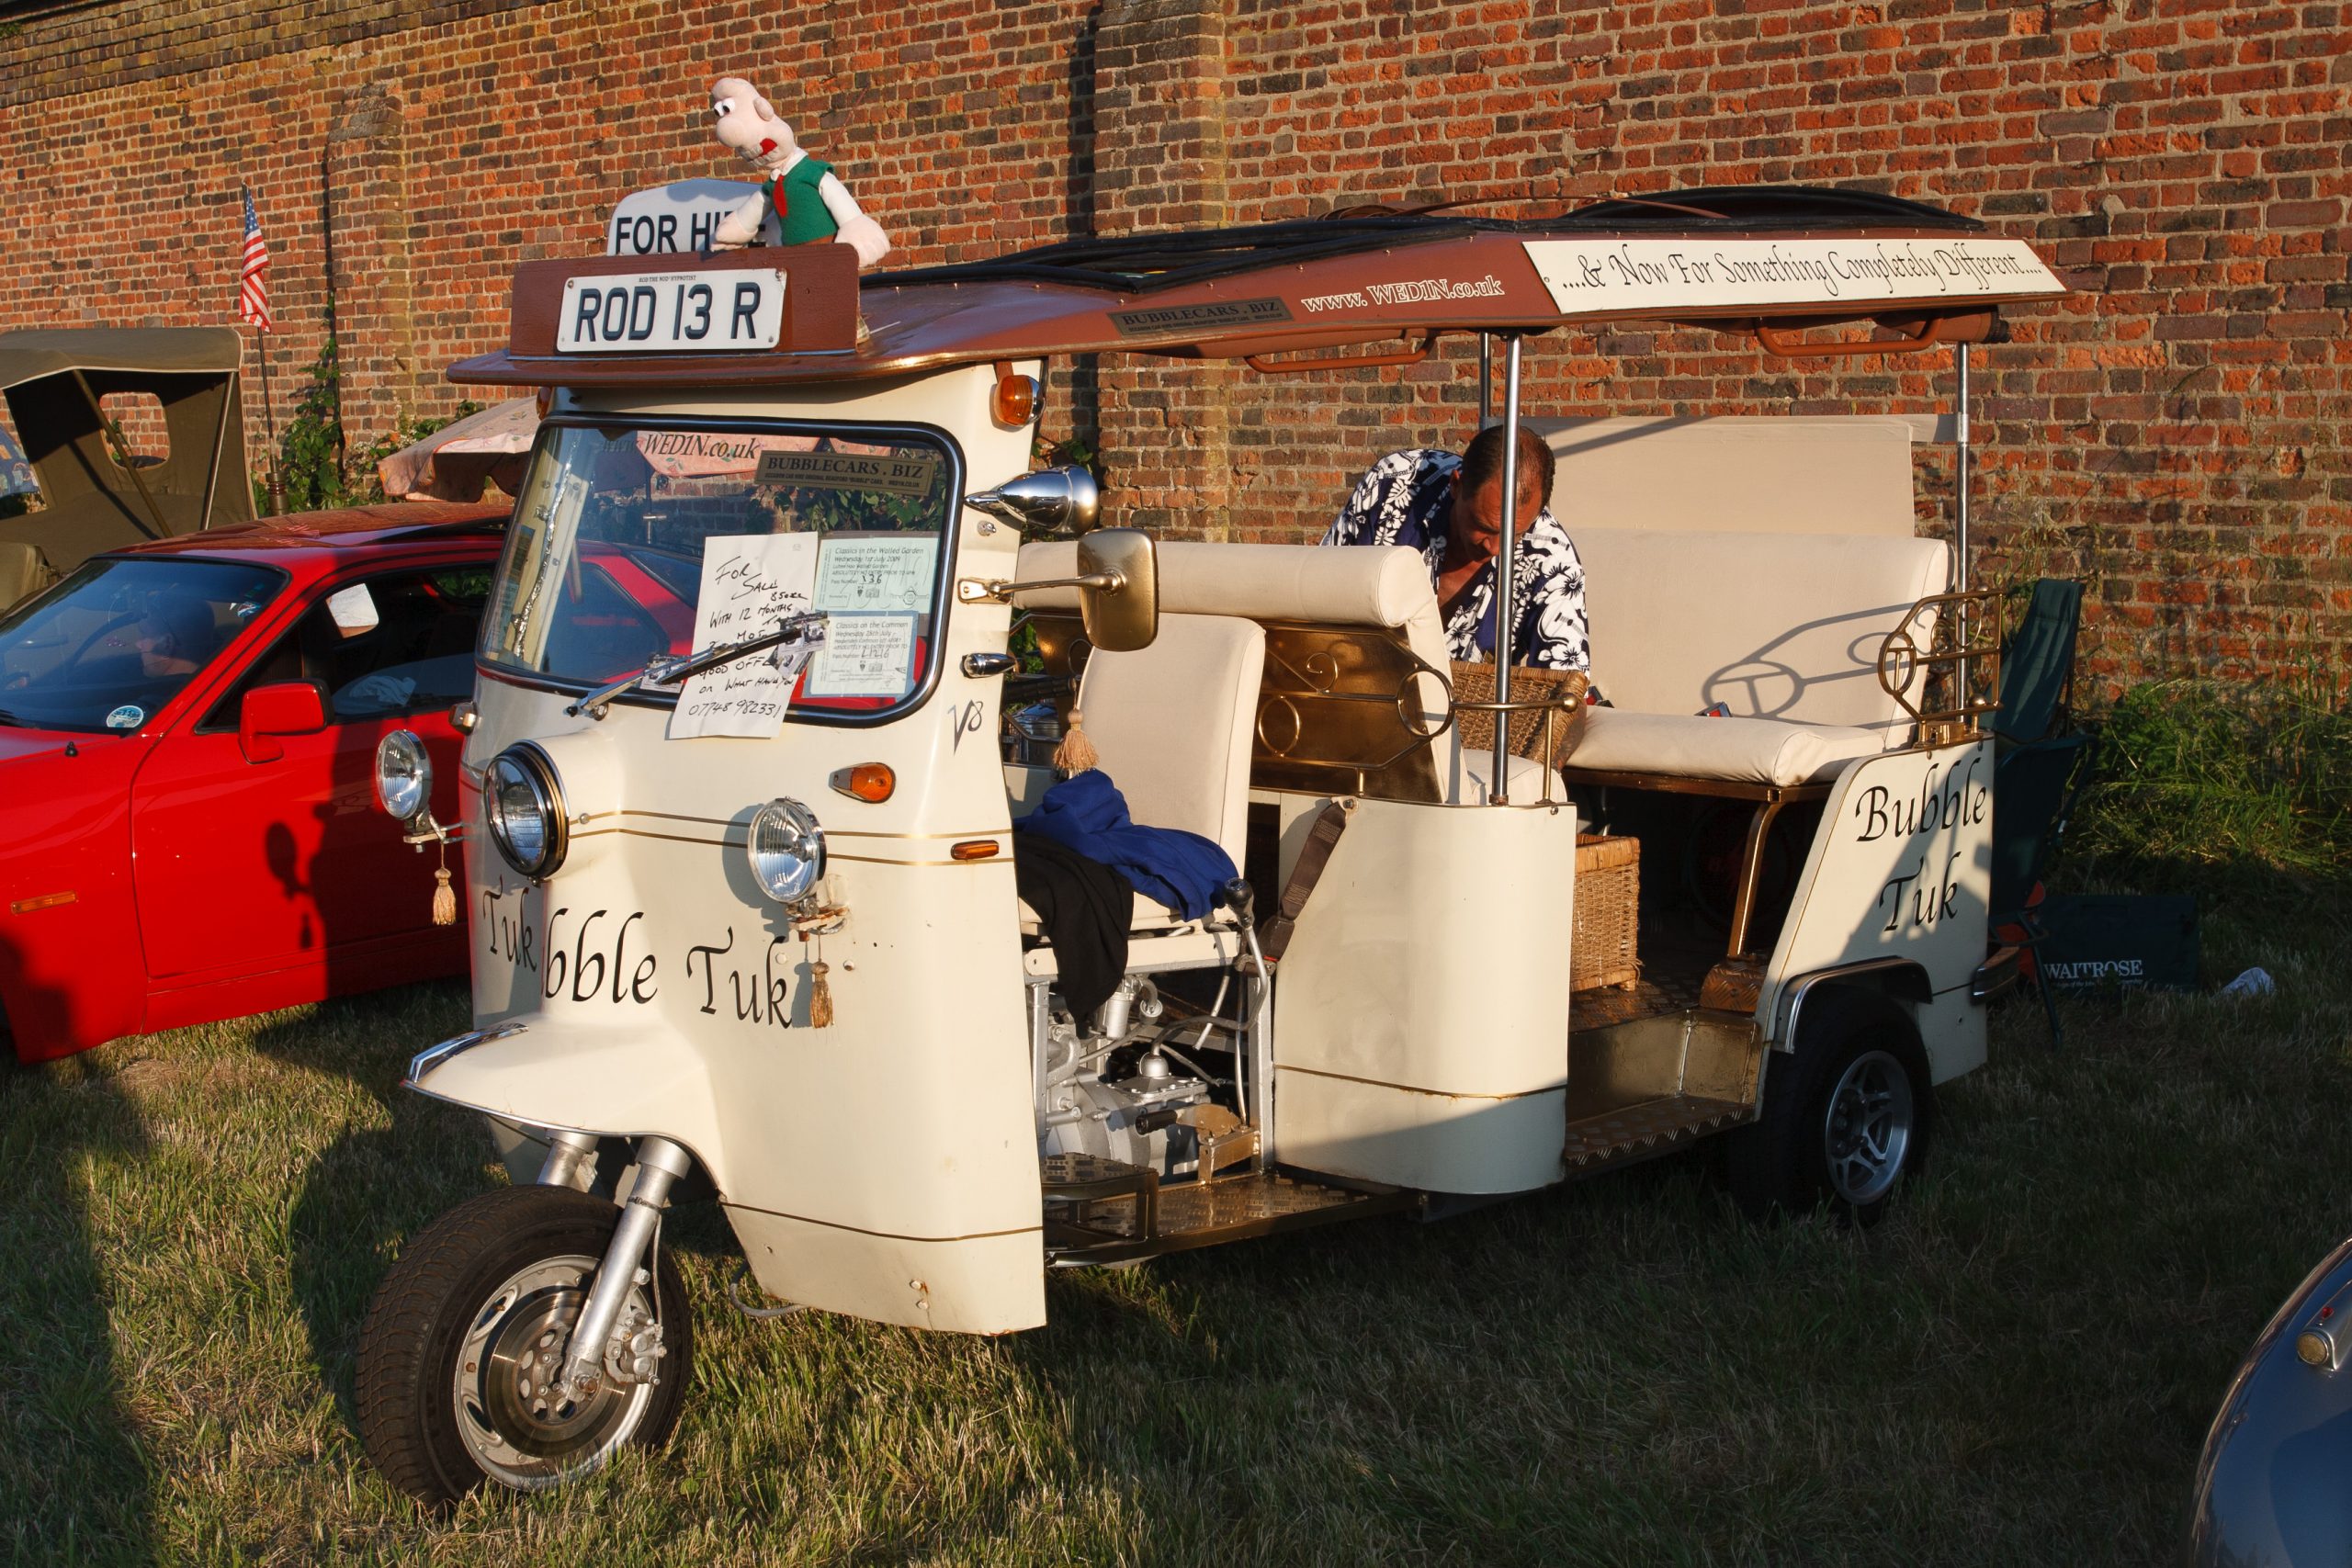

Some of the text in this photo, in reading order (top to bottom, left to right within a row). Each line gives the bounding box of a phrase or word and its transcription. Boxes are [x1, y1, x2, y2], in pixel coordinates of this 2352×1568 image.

[616, 210, 767, 254] FOR HI
[1609, 243, 1669, 286] Now
[1668, 254, 1714, 284] For
[1714, 244, 1838, 296] Something
[1828, 243, 1946, 294] Completely
[574, 282, 761, 342] ROD 13 R
[709, 611, 732, 628] WITH
[739, 607, 752, 621] 12
[947, 700, 984, 756] V8
[1855, 757, 1987, 841] Bubble
[1879, 852, 1962, 931] Tuk
[483, 874, 537, 973] Tuk
[544, 908, 793, 1029] bble Tuk
[2043, 960, 2143, 979] WAITROSE
